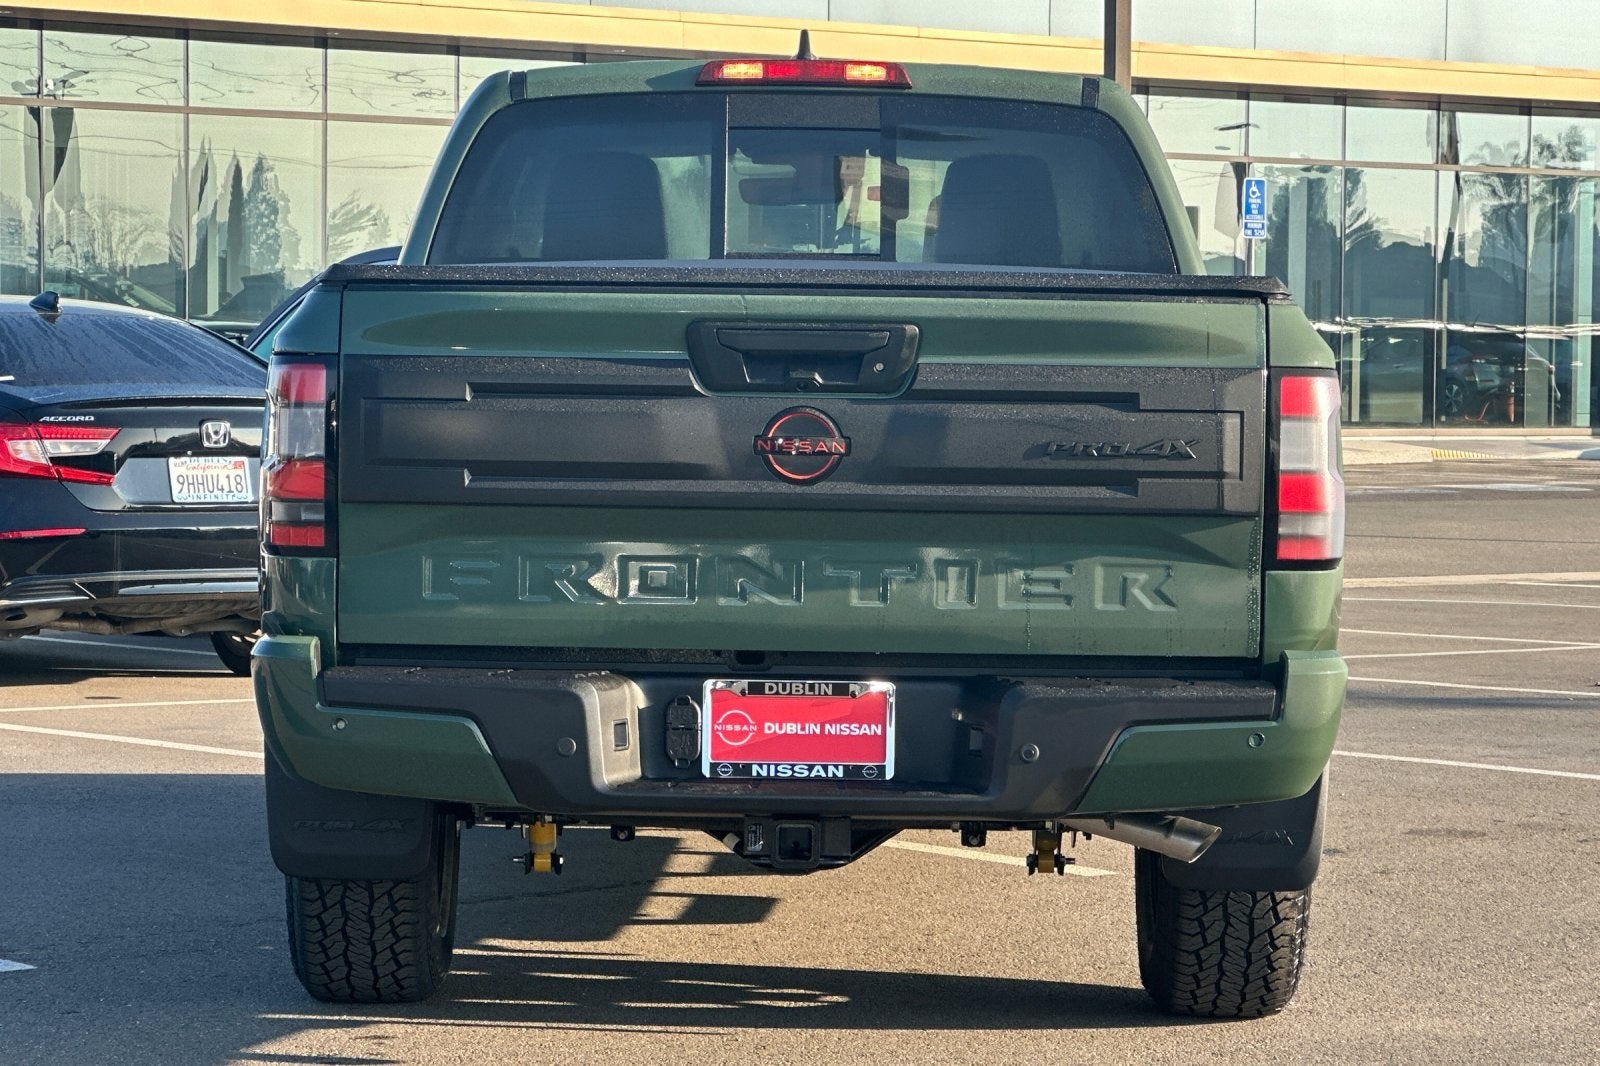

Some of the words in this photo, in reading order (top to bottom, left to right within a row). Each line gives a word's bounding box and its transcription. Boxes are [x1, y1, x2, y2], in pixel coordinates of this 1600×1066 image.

[757, 439, 846, 453] NISSAN
[176, 474, 244, 494] 9HHU418
[422, 553, 1178, 612] FRONTIER
[764, 683, 833, 696] DUBLIN
[714, 723, 757, 732] NISSAN
[764, 722, 821, 735] DUBLIN
[824, 723, 882, 736] NISSAN
[751, 763, 844, 778] NISSAN
